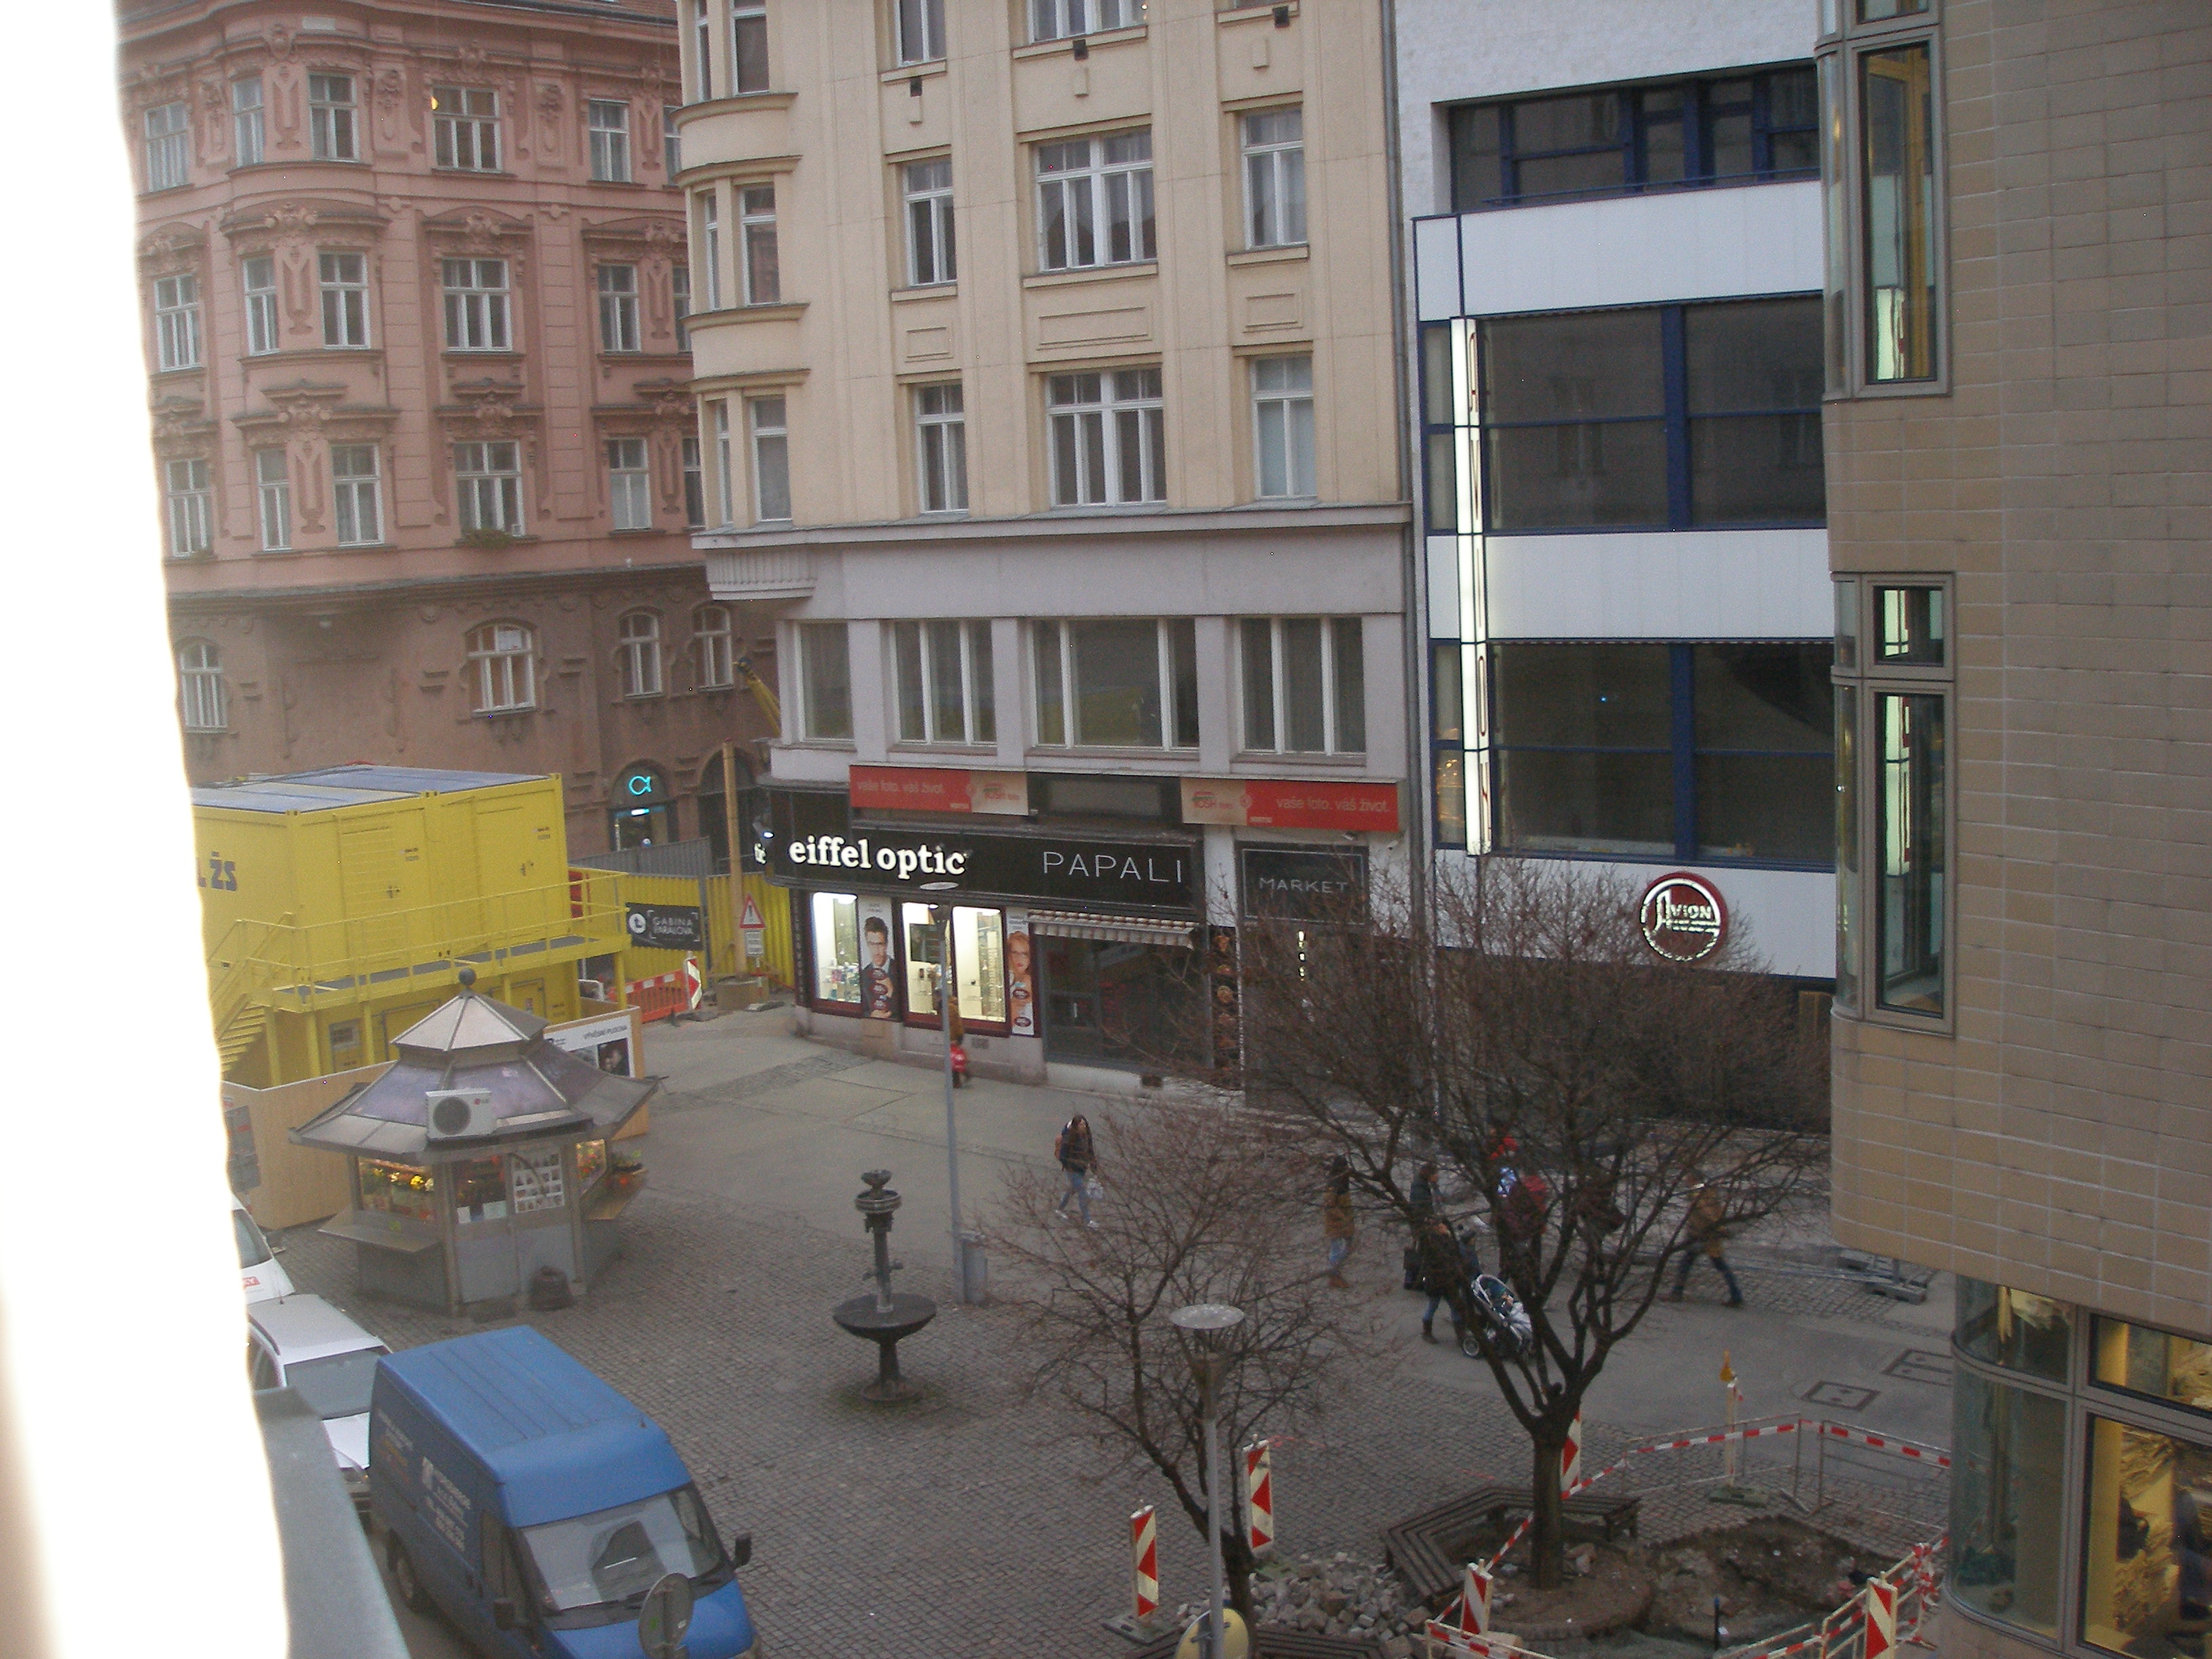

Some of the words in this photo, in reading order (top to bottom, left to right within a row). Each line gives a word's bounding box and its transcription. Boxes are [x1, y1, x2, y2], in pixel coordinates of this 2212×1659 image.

[1276, 796, 1304, 809] vaše
[789, 834, 872, 869] eiffel
[876, 844, 966, 880] optic
[1043, 851, 1182, 883] PAPALI
[1258, 877, 1348, 894] MARKET
[1652, 888, 1712, 935] AVION
